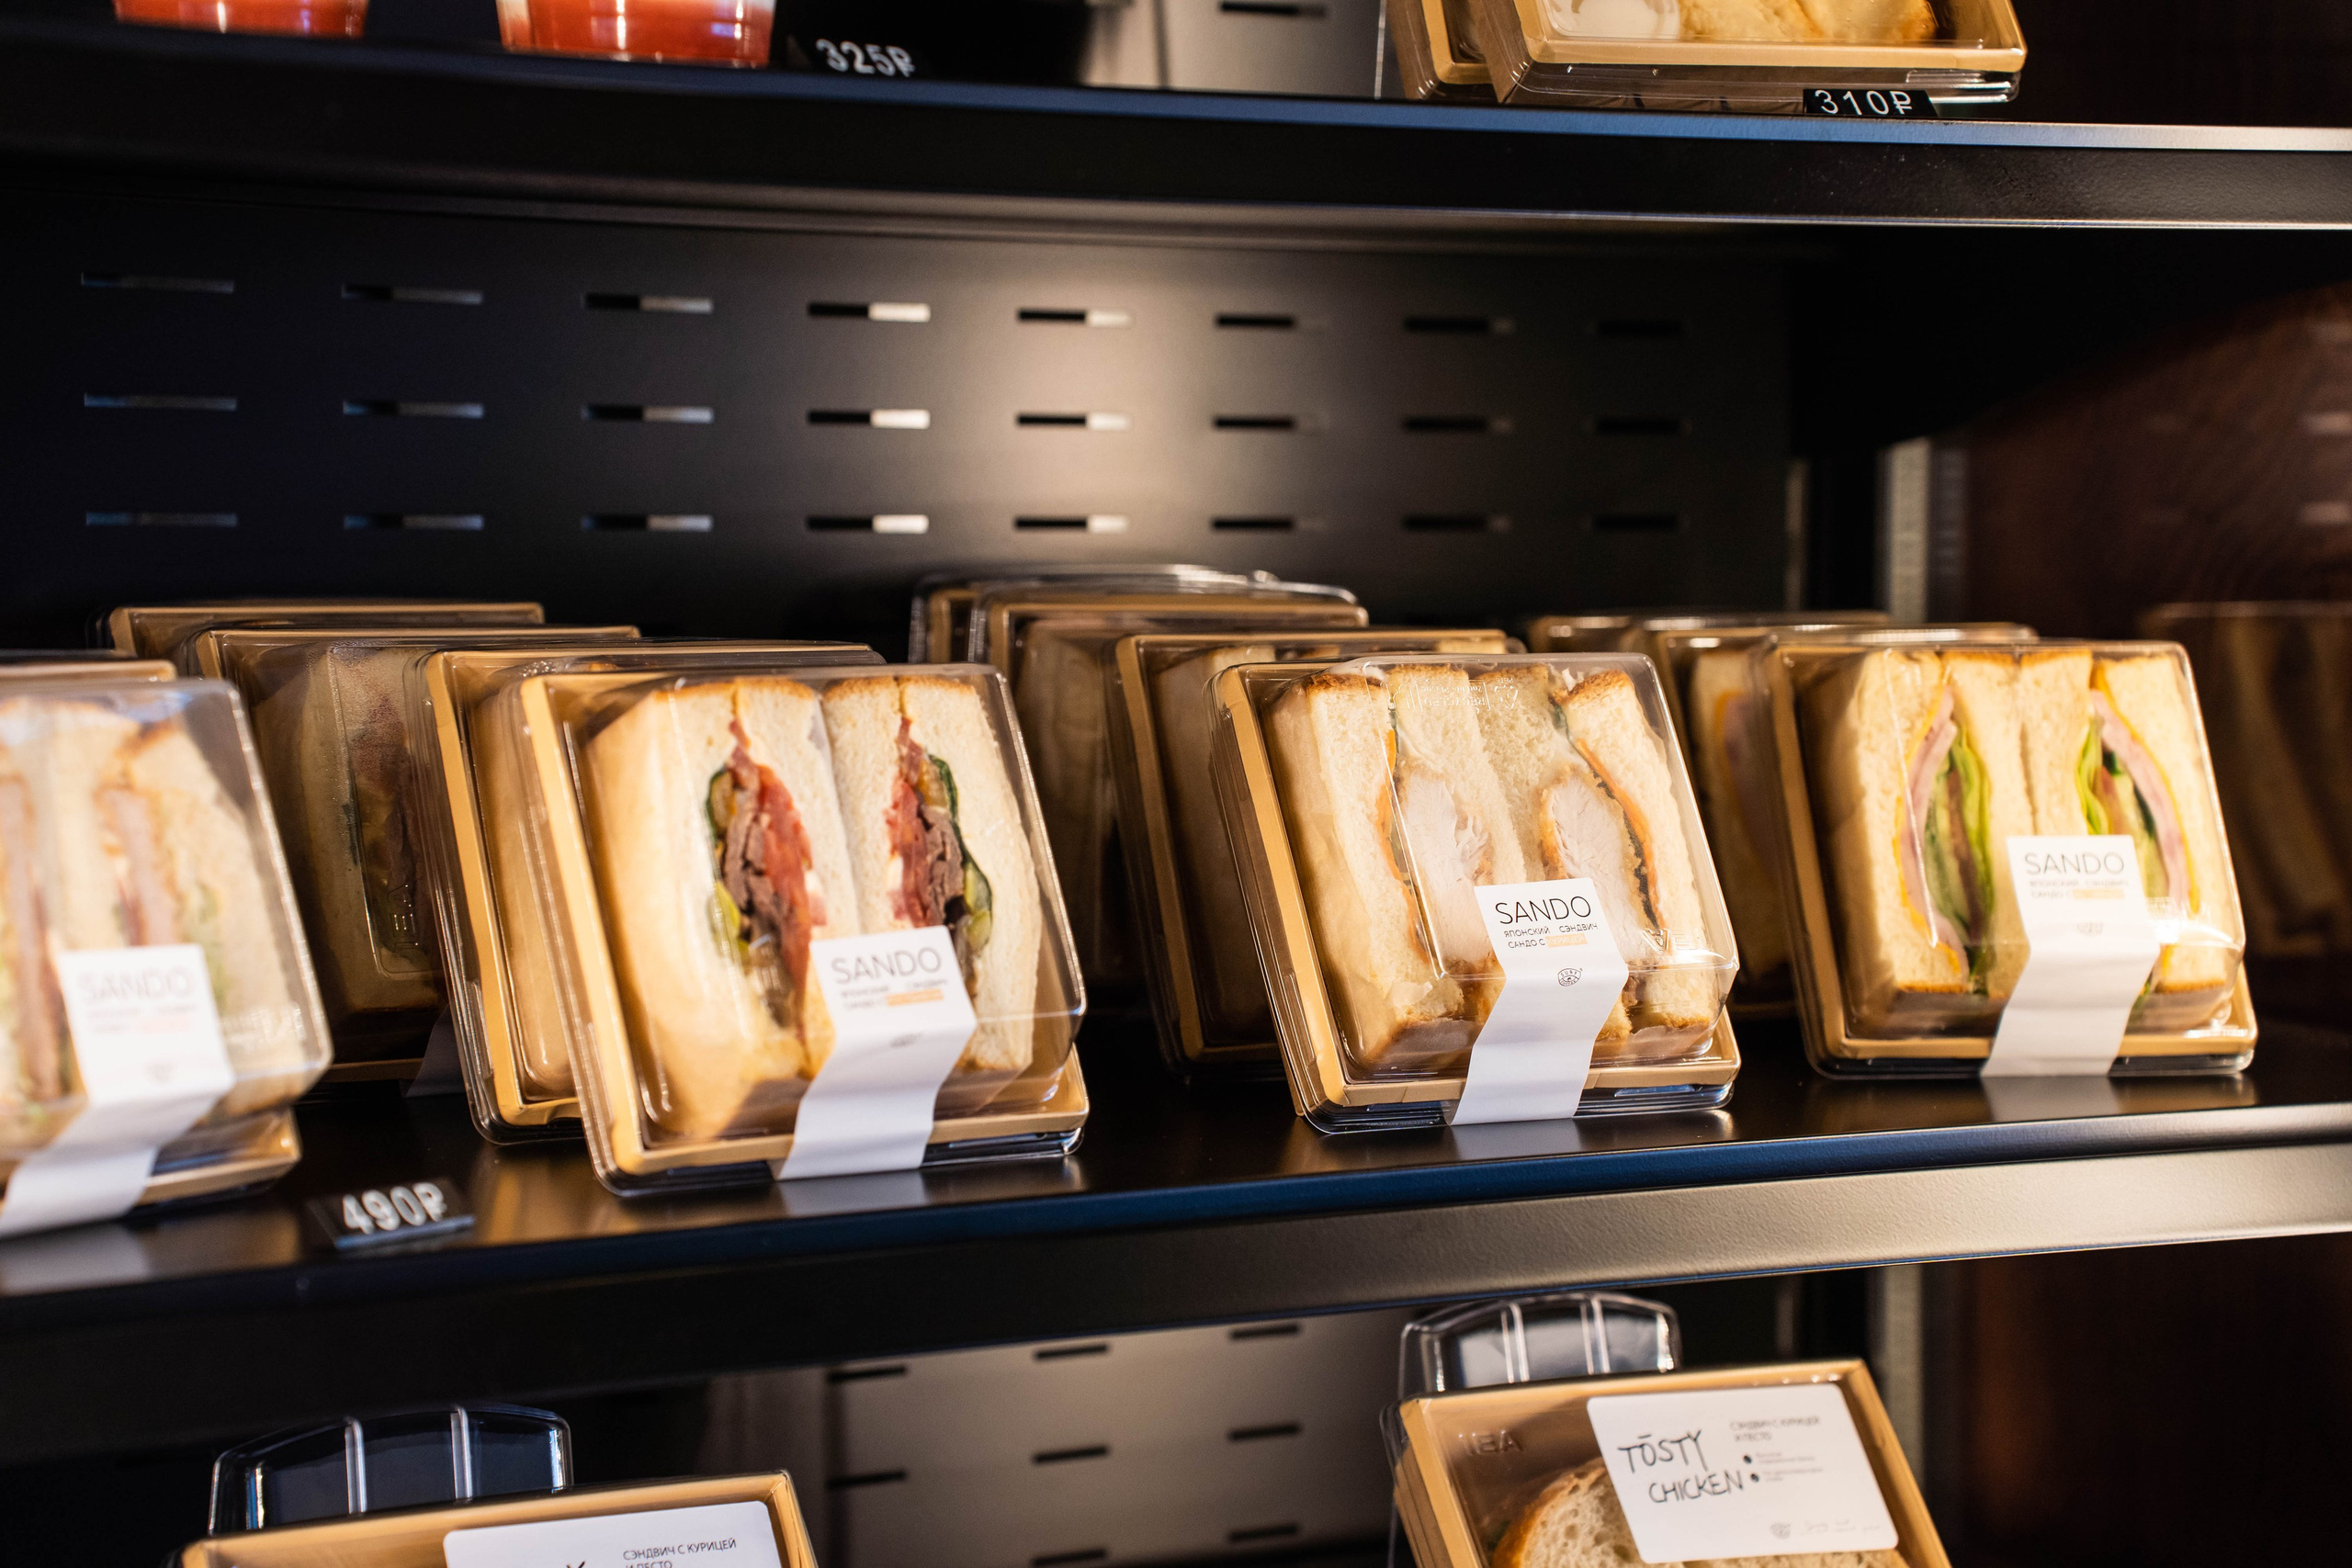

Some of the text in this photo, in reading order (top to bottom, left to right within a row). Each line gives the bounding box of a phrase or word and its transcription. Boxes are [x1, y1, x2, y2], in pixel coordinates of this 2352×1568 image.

[1814, 89, 1913, 116] 310₽
[2025, 852, 2125, 875] SANDO
[1495, 896, 1591, 925] SANDO
[1503, 922, 1599, 938] ЯПОНСКИЙ СЭНДВИЧ
[1508, 939, 1538, 949] САНДО
[1538, 938, 1546, 946] С
[831, 946, 942, 985] SANDO
[78, 966, 195, 1006] SANDO
[1649, 1470, 1744, 1504] CHICKEN
[623, 1538, 737, 1561] СЭНДВИЧ С КУРИЦЕЙ
